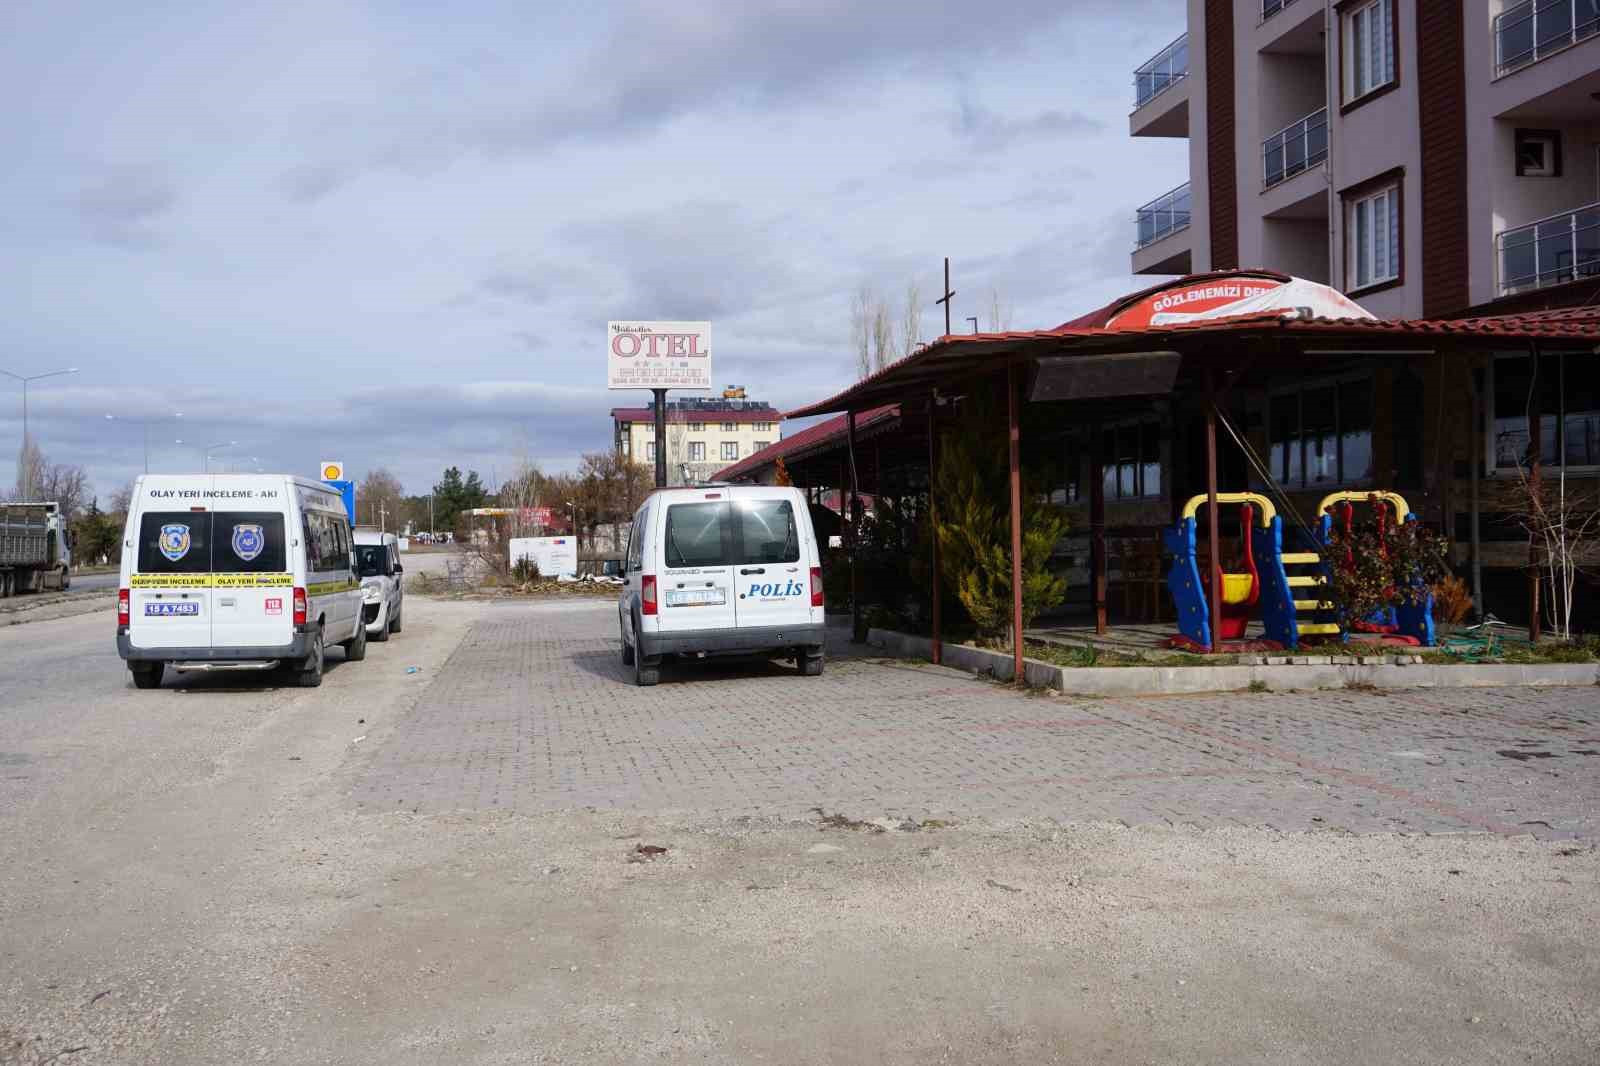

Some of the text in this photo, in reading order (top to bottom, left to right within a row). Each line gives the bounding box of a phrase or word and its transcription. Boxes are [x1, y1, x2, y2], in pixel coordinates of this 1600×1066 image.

[1153, 284, 1241, 312] GÖZLEMEMİZİ
[612, 333, 708, 357] OTEL
[150, 490, 175, 498] OLAY
[748, 579, 803, 596] POLİS
[162, 603, 170, 613] A
[267, 600, 281, 608] 112
